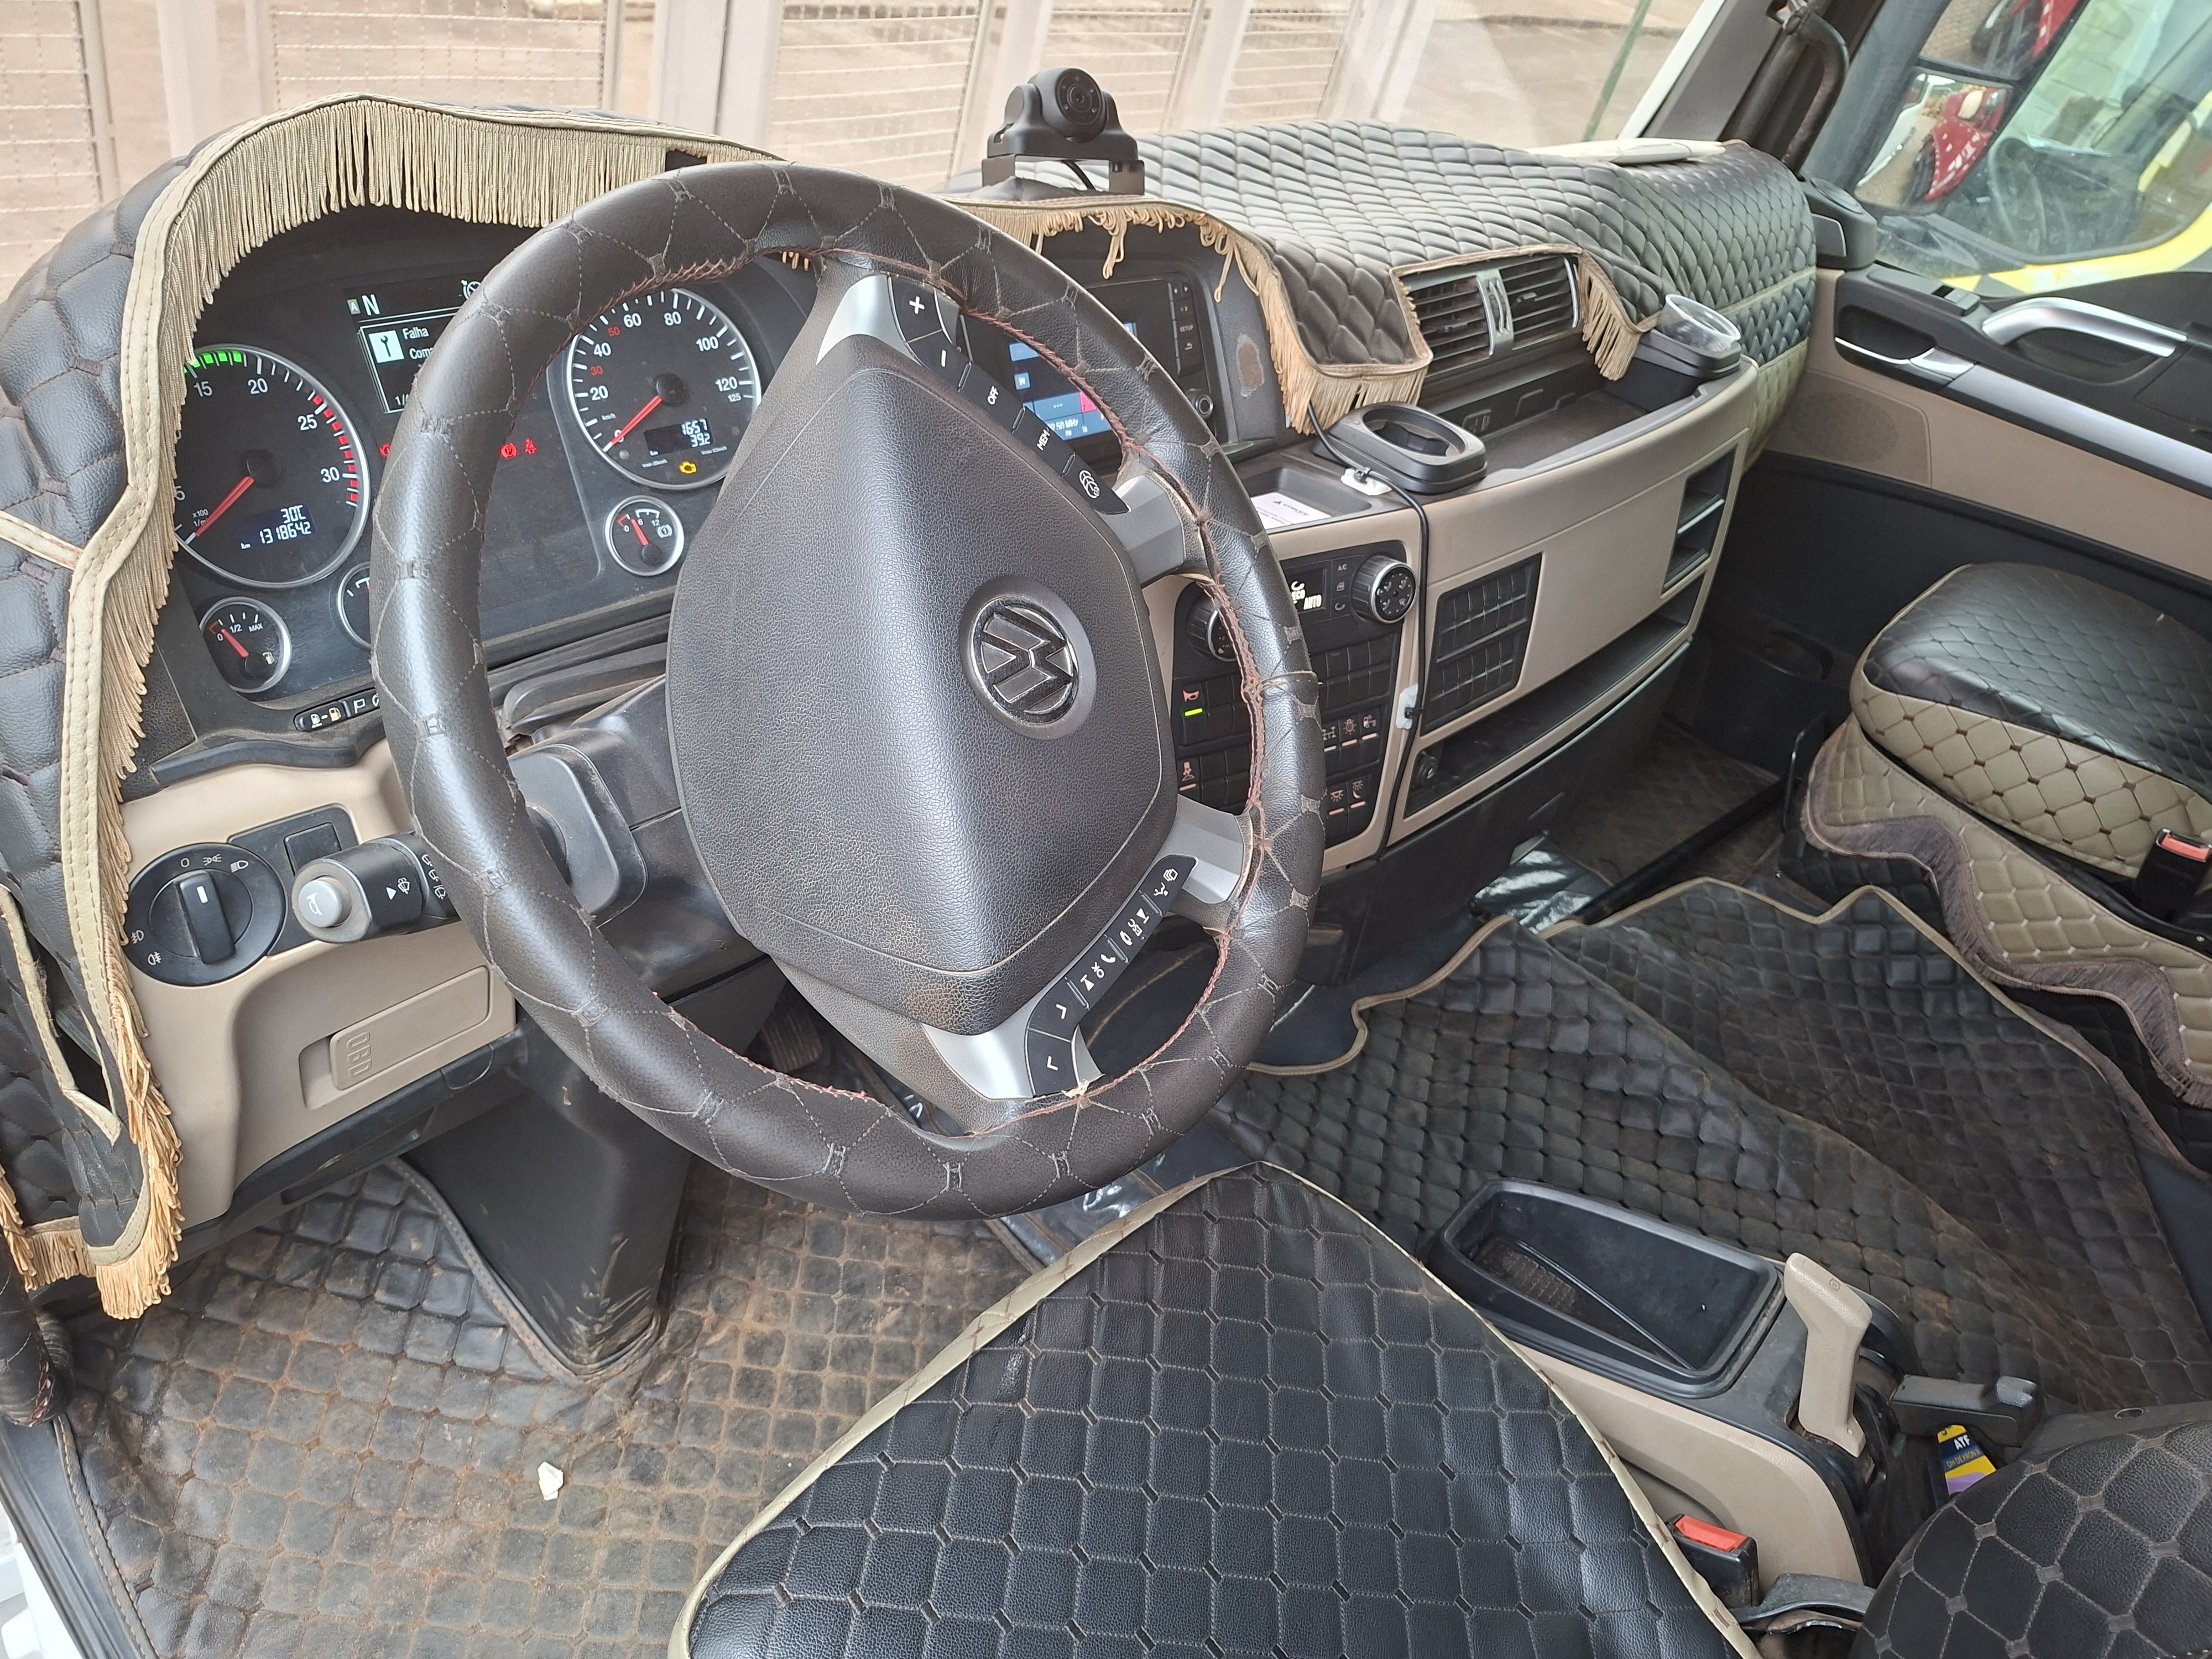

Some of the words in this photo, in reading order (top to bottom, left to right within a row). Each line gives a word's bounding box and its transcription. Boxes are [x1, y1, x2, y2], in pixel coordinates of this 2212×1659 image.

[362, 294, 380, 316] N
[623, 313, 641, 327] 60
[664, 311, 681, 326] 80
[402, 327, 429, 340] Falha
[608, 326, 620, 336] 50
[593, 342, 611, 357] 40
[696, 336, 719, 352] 100
[591, 366, 603, 376] 30
[194, 381, 213, 397] 15
[248, 378, 268, 394] 20
[715, 376, 738, 392] 120
[590, 385, 608, 401] 20
[727, 393, 742, 402] 125
[987, 385, 999, 405] OFF
[298, 414, 317, 431] 25
[690, 432, 711, 447] 392
[1036, 429, 1050, 451] MEM
[320, 467, 340, 483] 30
[192, 509, 208, 518] x100
[193, 518, 208, 527] 1/m
[259, 521, 311, 544] 1318642
[1303, 594, 1322, 611] AUTO
[229, 624, 242, 633] 1/2
[249, 623, 263, 632] MAX
[1128, 919, 1142, 937] ESC
[1091, 962, 1104, 978] OK
[347, 1032, 372, 1077] OBD
[1954, 1434, 1970, 1450] ATF
